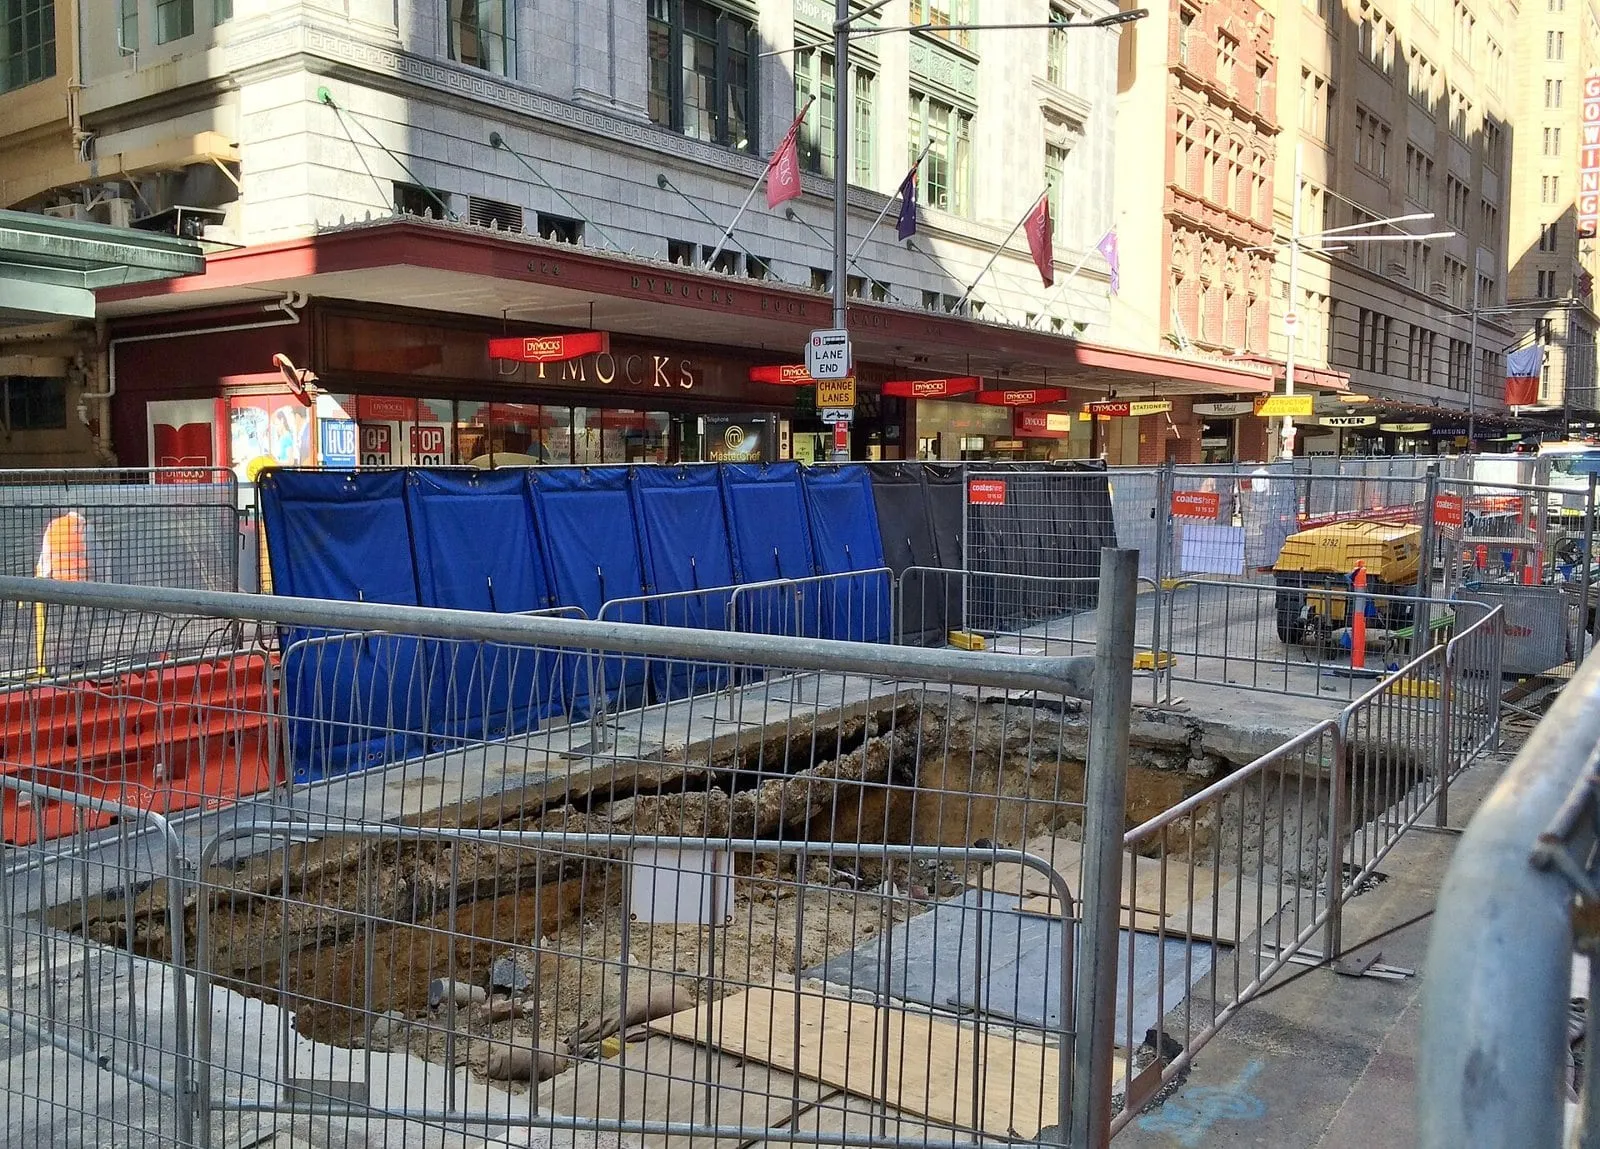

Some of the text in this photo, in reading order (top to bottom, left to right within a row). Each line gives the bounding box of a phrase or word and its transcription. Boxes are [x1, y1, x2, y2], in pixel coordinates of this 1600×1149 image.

[1582, 78, 1600, 236] GOWINGS
[632, 275, 734, 304] DYMOCKS
[527, 341, 560, 352] DYMOCKS
[815, 350, 843, 360] LANE
[819, 363, 838, 373] END
[819, 381, 853, 391] CHANGE
[915, 382, 944, 392] DYMOCKS
[822, 394, 850, 403] LANES
[1006, 392, 1034, 402] DYMOCKS
[1092, 402, 1171, 412] DYMOCKS STATIONERY
[1256, 398, 1310, 407] CONSTRUCTION
[1329, 417, 1365, 425] MYER
[329, 429, 354, 454] HUB
[710, 451, 761, 461] MasterChef
